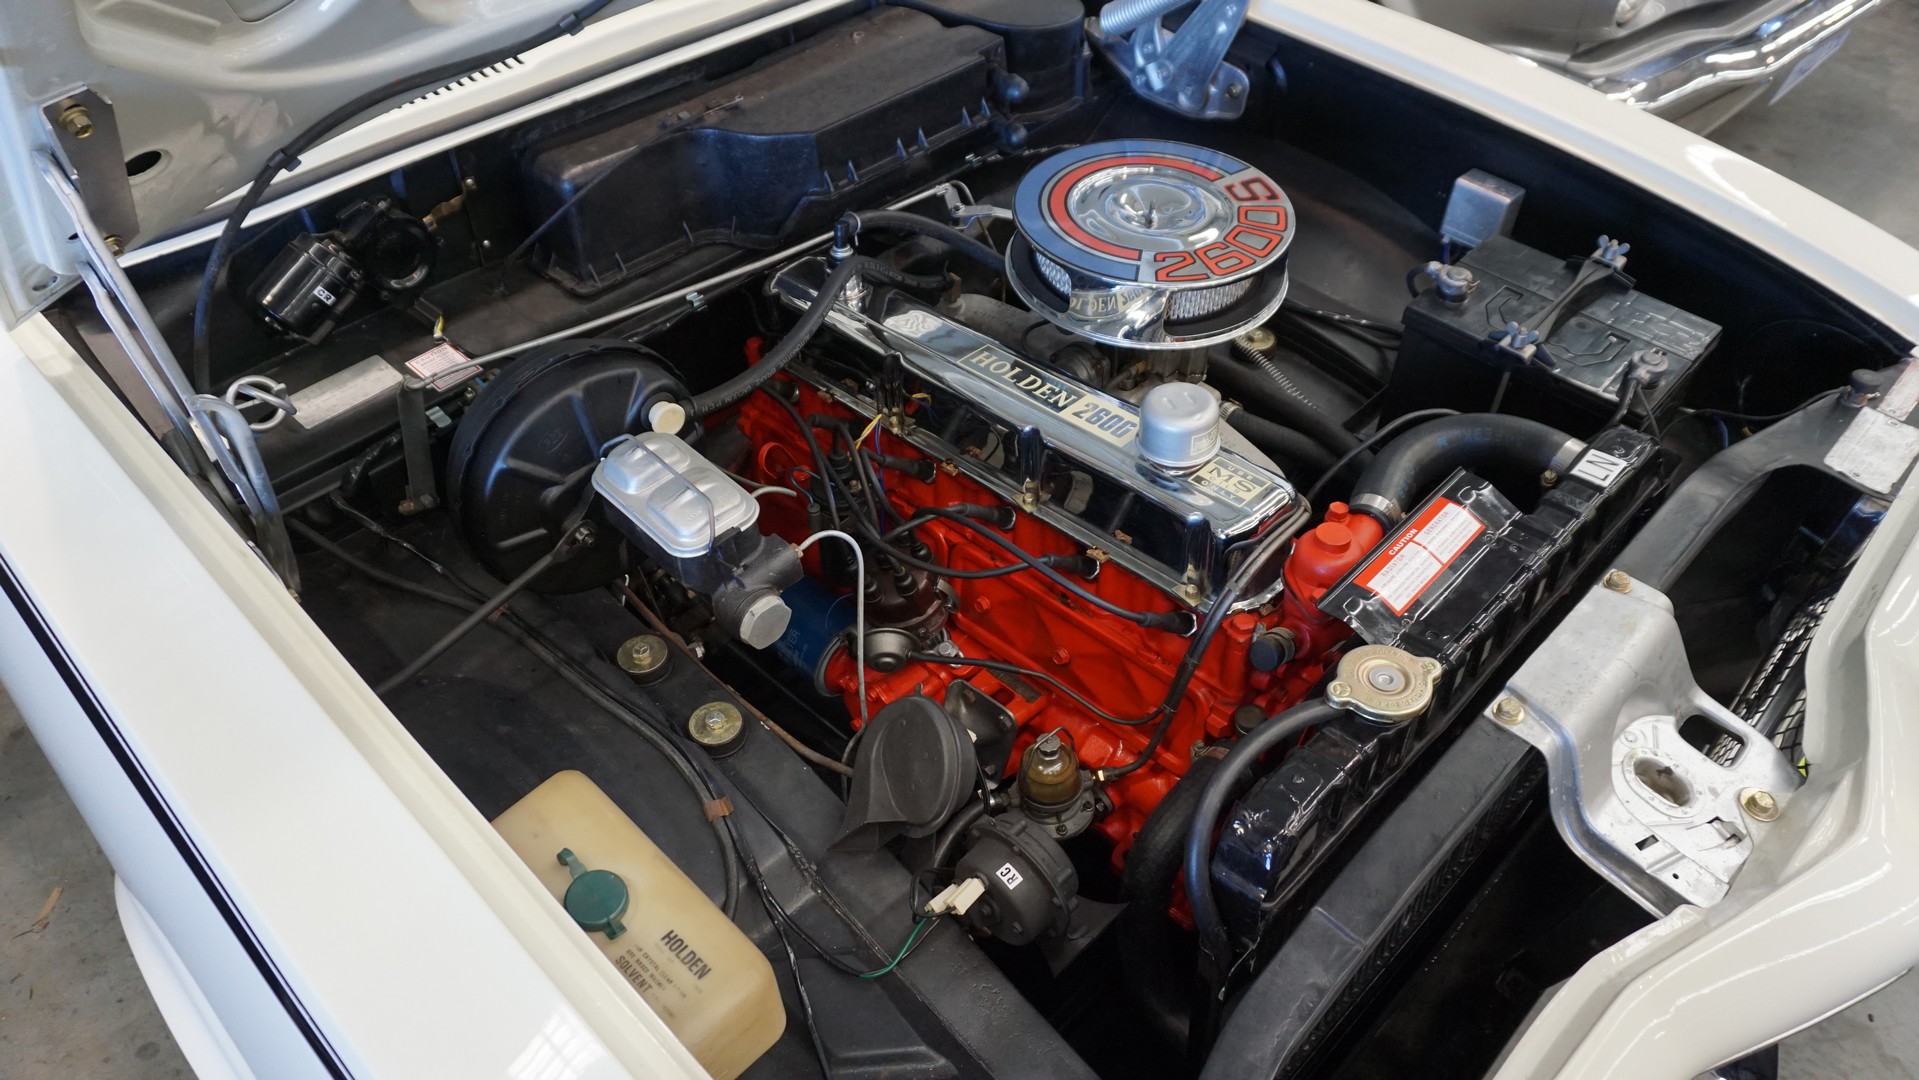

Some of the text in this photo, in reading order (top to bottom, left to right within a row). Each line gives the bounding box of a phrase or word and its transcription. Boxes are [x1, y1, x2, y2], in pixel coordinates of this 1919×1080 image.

[1153, 176, 1288, 282] 2600S
[317, 288, 332, 302] CR
[969, 351, 1078, 408] HOLDEN
[1208, 466, 1257, 493] MS
[1578, 453, 1620, 481] LN
[1201, 480, 1236, 499] ONLY
[1424, 511, 1449, 536] GENERATOR
[1388, 528, 1418, 556] CAUTION
[1381, 553, 1405, 577] RADIATOR
[1000, 867, 1019, 885] RC
[642, 952, 661, 972] CRYSTAL
[660, 929, 712, 980] HOLDEN
[615, 955, 653, 993] SOLVENT
